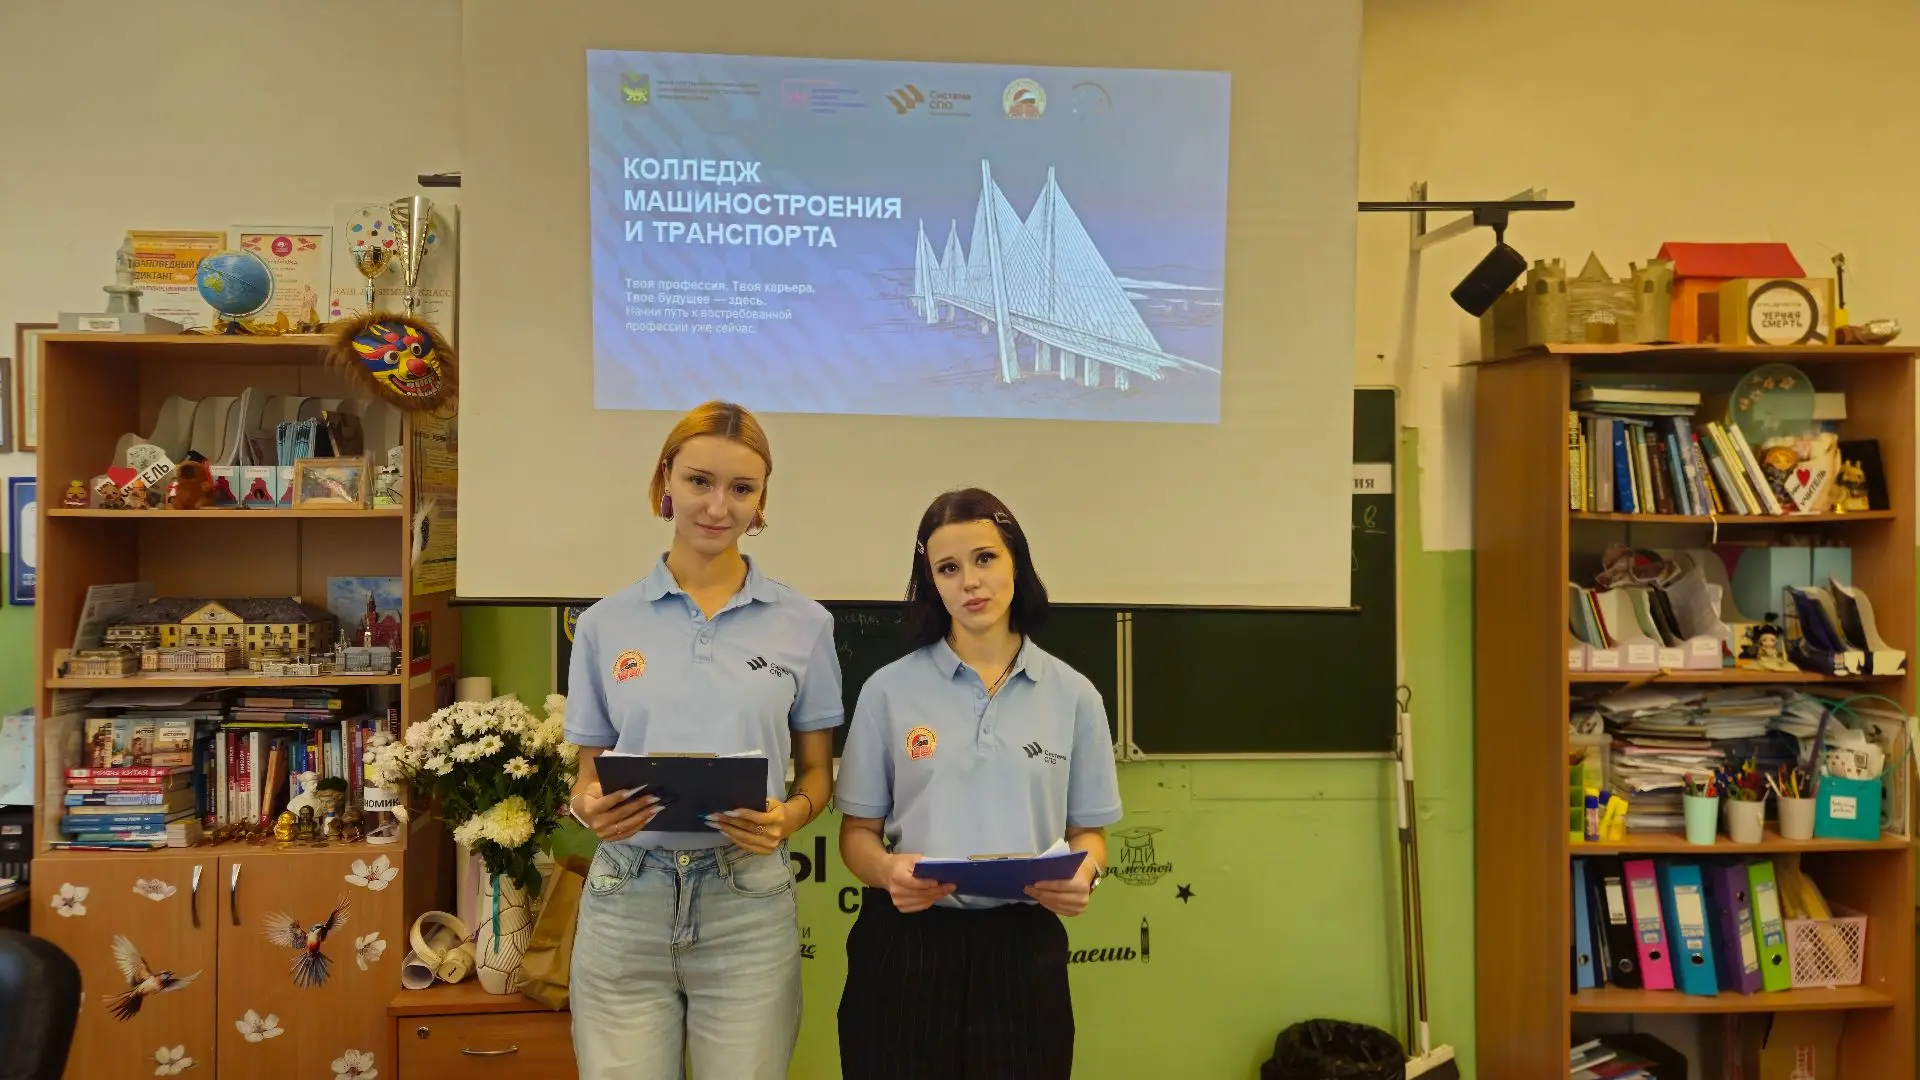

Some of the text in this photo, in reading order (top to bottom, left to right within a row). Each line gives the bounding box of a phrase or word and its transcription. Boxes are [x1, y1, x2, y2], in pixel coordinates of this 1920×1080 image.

[623, 157, 761, 186] КОЛЛЕДЖ
[624, 189, 901, 219] МАШИНОСТРОЕНИЯ
[624, 220, 837, 247] И ТРАНСПОРТА
[625, 278, 653, 290] Твоя
[658, 279, 729, 293] профессия.
[732, 280, 761, 292] Твоя
[625, 292, 654, 303] Твое
[657, 292, 710, 306] будущее
[728, 296, 767, 307] здесь.
[625, 305, 792, 321] Начни путь к востребованной
[625, 321, 689, 334] профессии
[691, 324, 712, 335] уже
[1120, 848, 1155, 864] ИДИ
[1100, 862, 1173, 878] за мечтой
